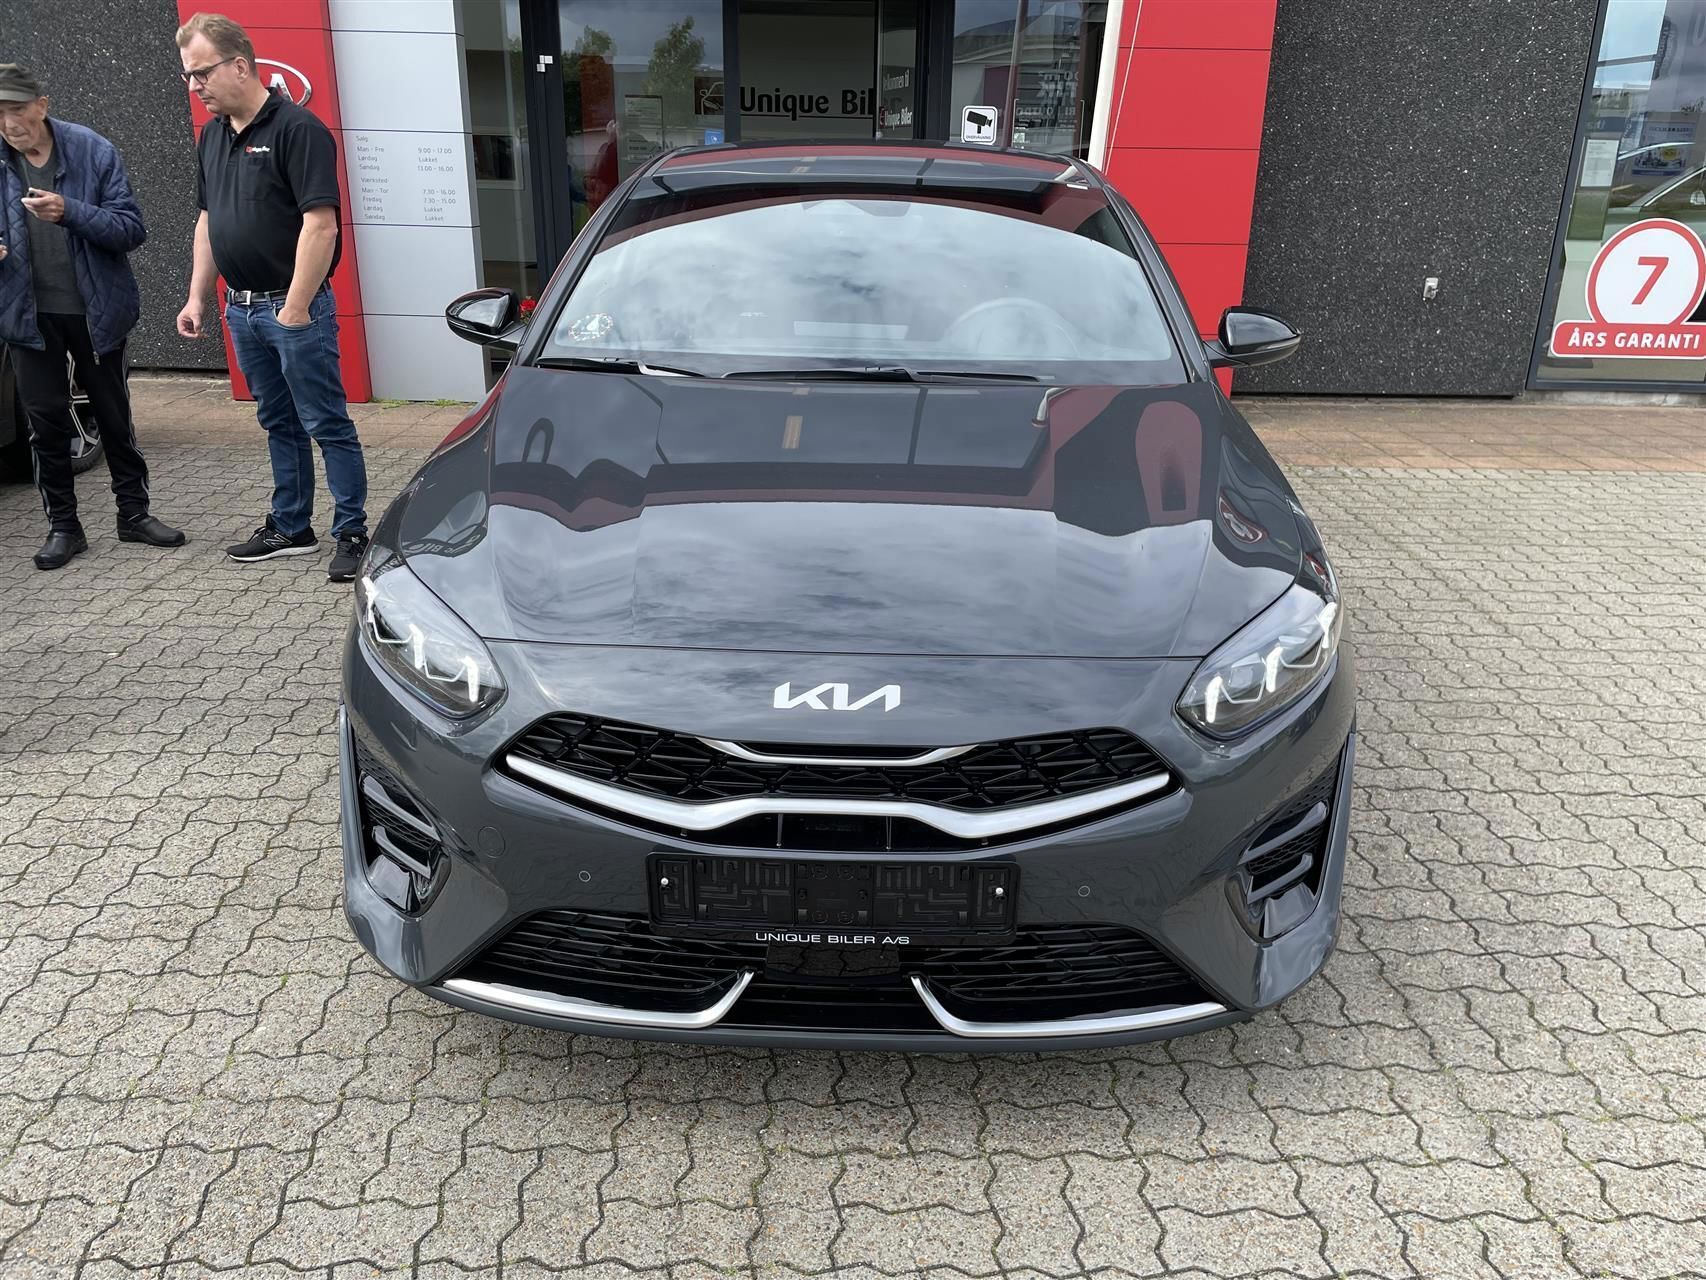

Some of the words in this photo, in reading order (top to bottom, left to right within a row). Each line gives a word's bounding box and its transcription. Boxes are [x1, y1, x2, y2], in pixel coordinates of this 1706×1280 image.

[739, 86, 830, 121] Unique
[364, 213, 386, 221] Søndag
[1631, 256, 1670, 305] 7
[1567, 327, 1607, 348] ÅRS
[1614, 332, 1700, 349] GARANTI
[773, 681, 901, 713] KIA
[755, 932, 821, 943] UNIQUE
[827, 935, 876, 944] BILER
[881, 936, 910, 945] A/S
